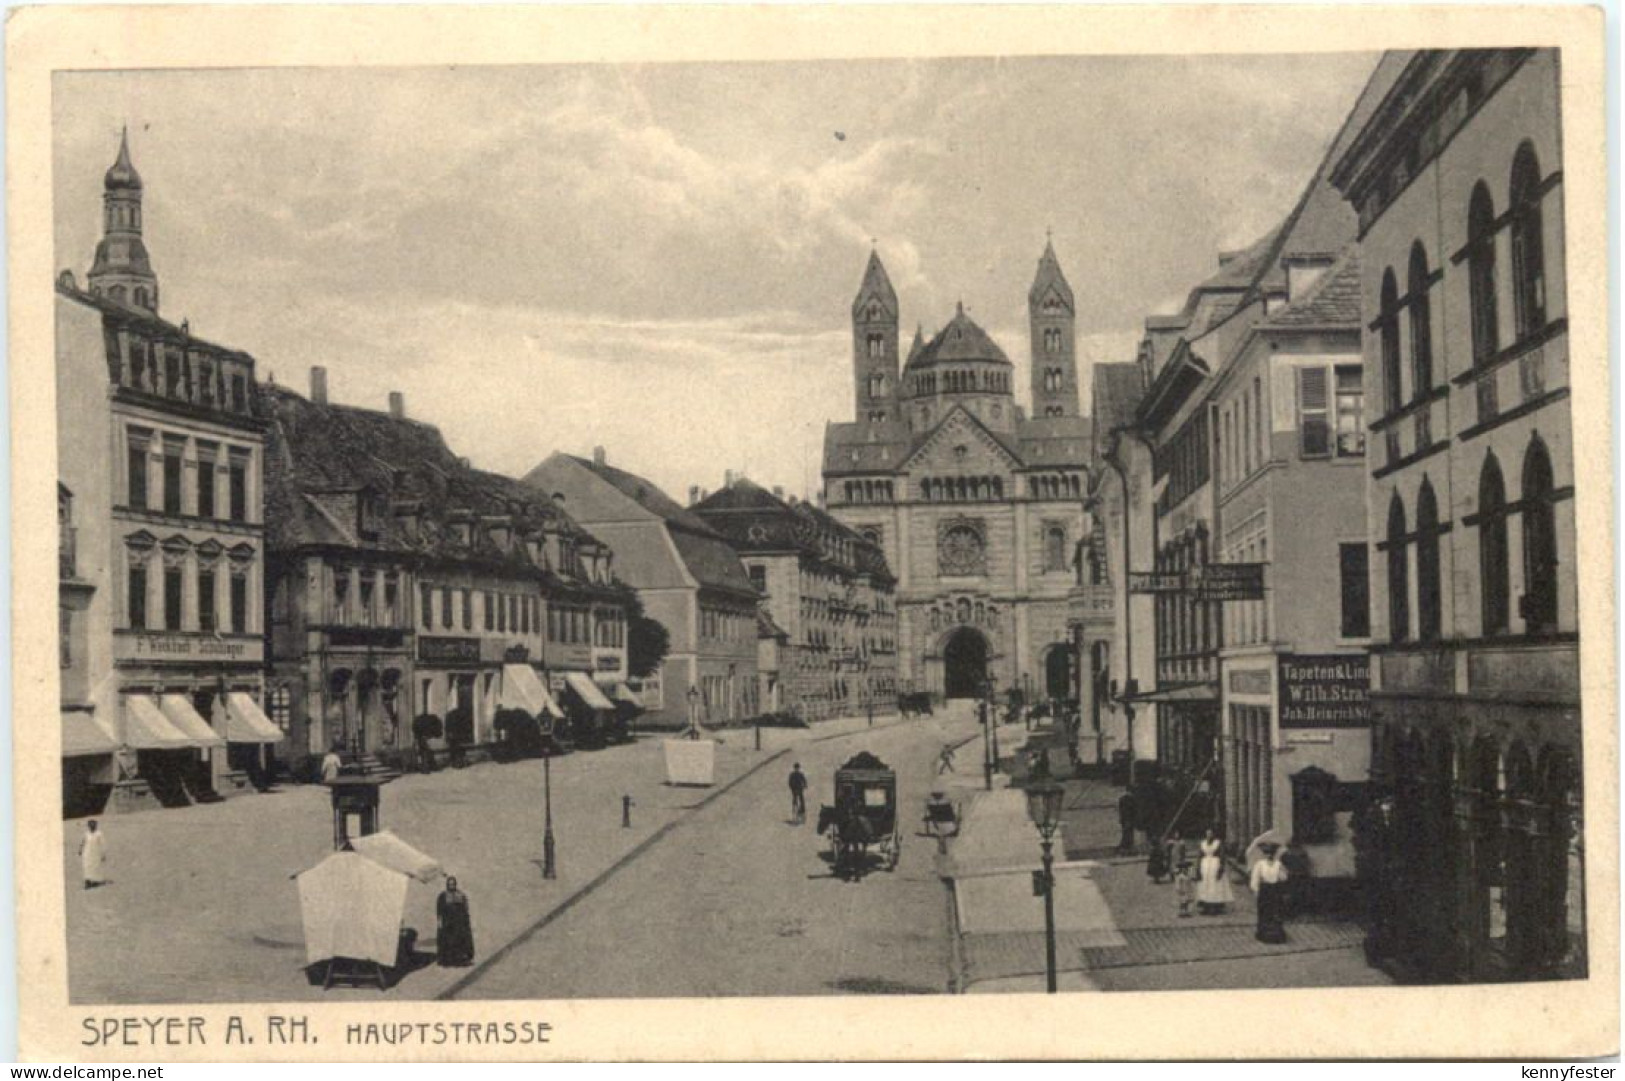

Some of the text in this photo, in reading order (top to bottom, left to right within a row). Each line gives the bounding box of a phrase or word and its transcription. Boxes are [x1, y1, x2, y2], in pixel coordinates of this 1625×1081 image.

[82, 1016, 552, 1046] SPEYER A. RH. HAUPTSTRASSE
